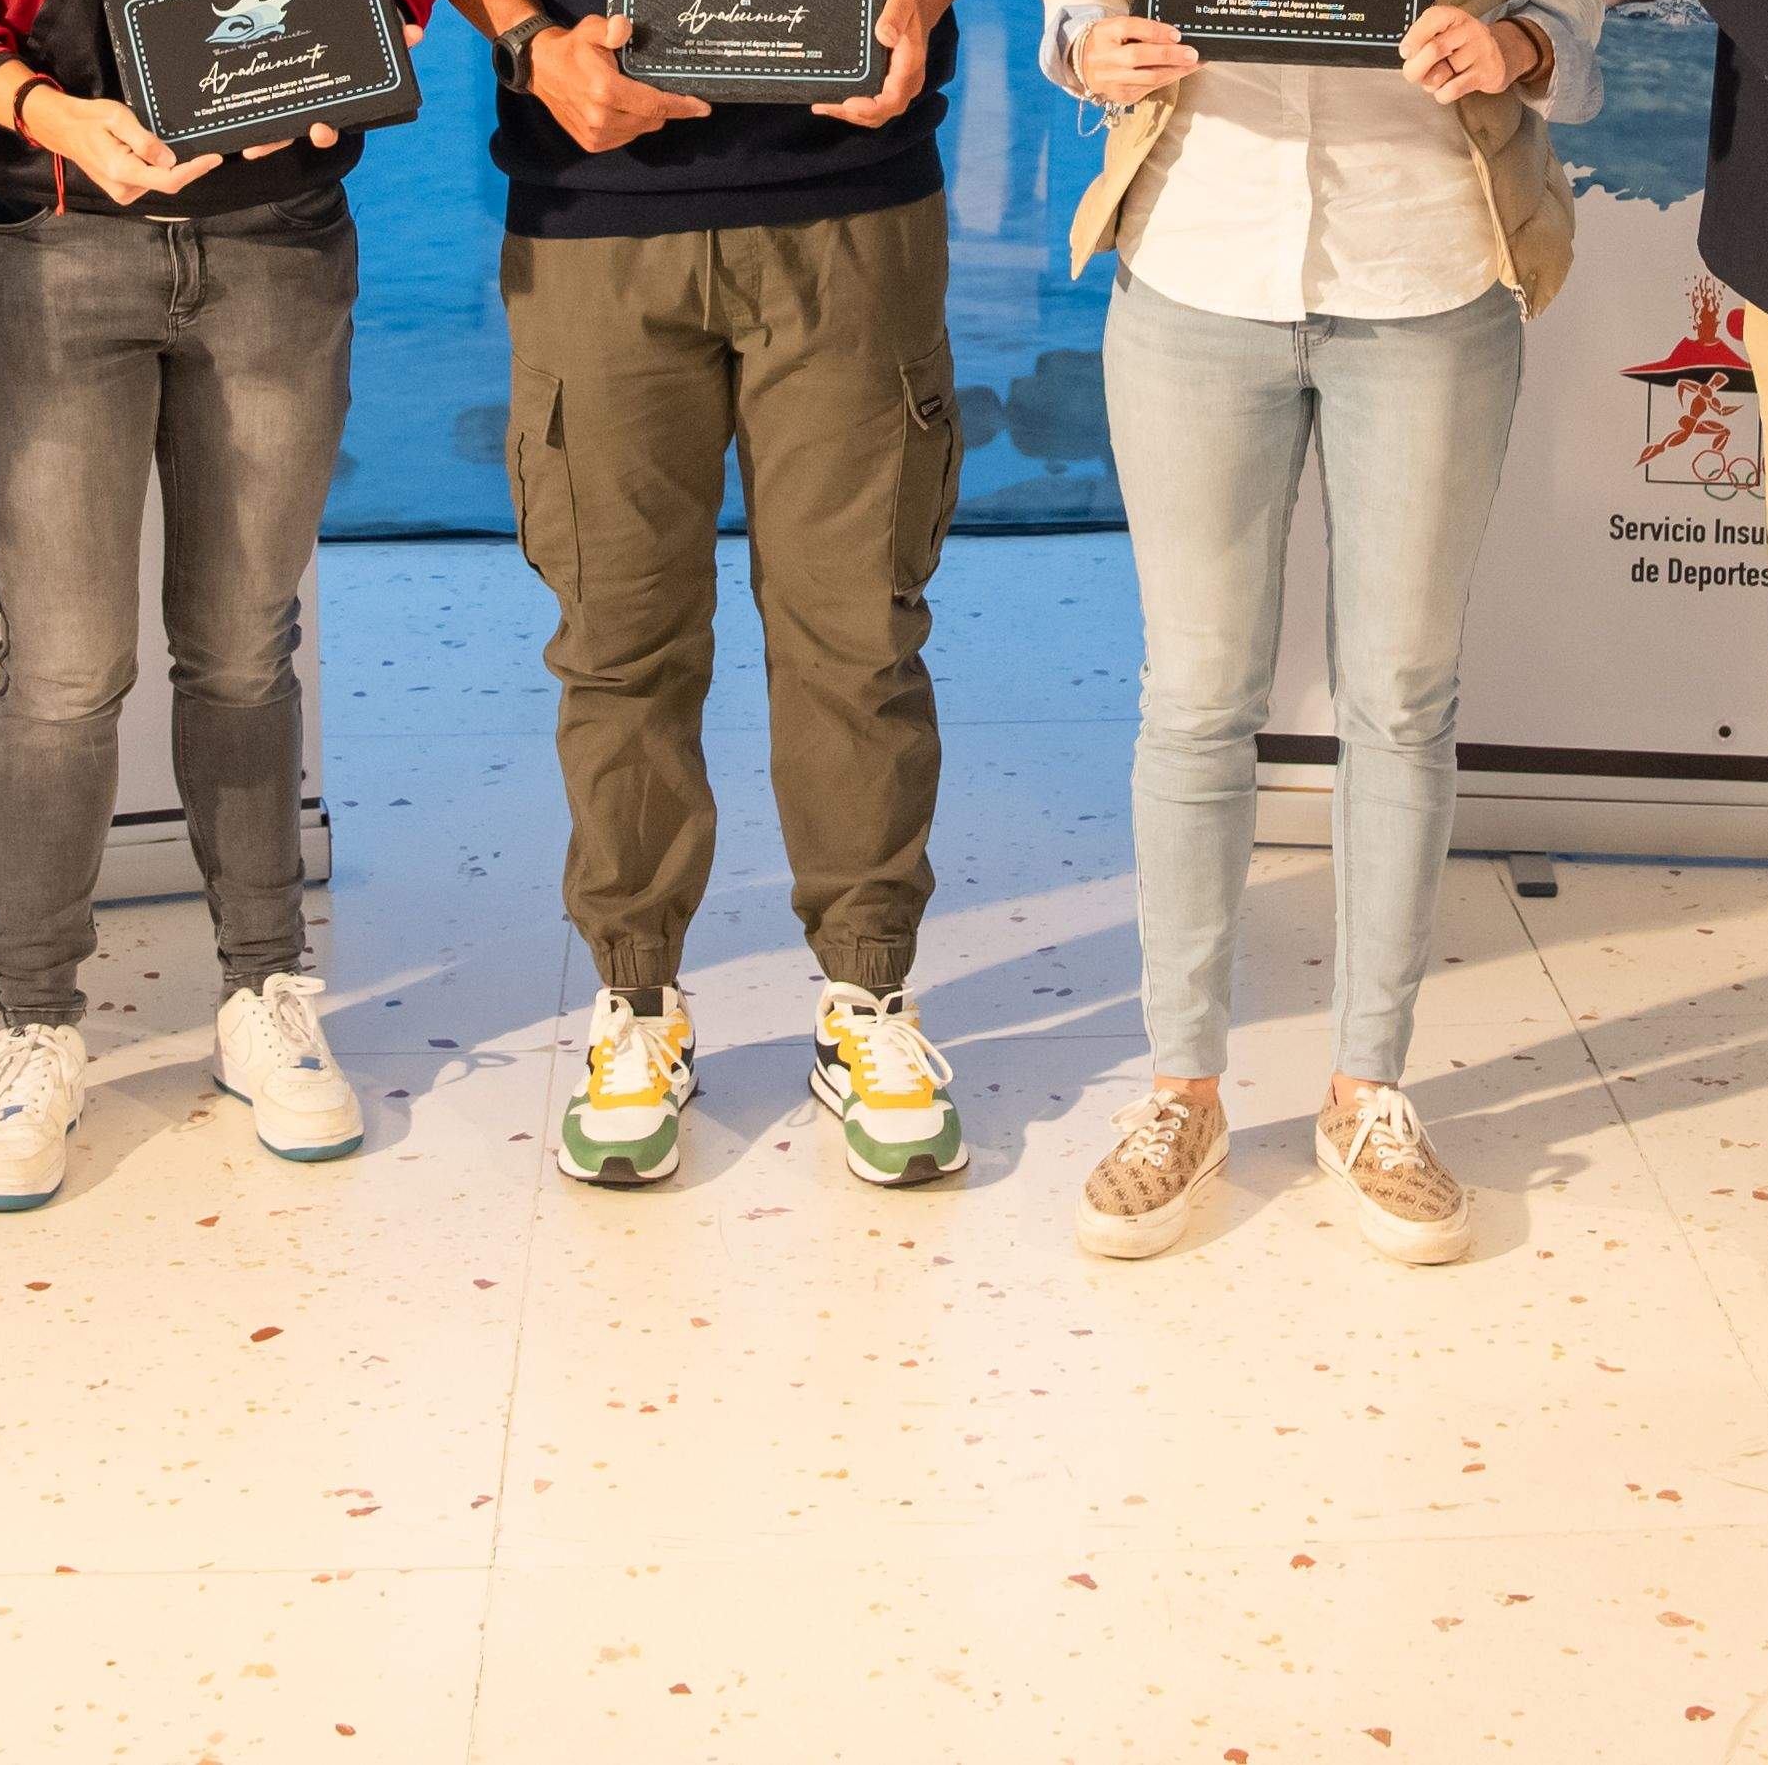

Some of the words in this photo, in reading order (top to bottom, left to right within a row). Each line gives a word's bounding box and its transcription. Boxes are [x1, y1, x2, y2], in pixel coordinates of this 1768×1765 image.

[257, 51, 268, 59] en
[1609, 514, 1706, 543] Servicio
[1631, 557, 1659, 582] de
